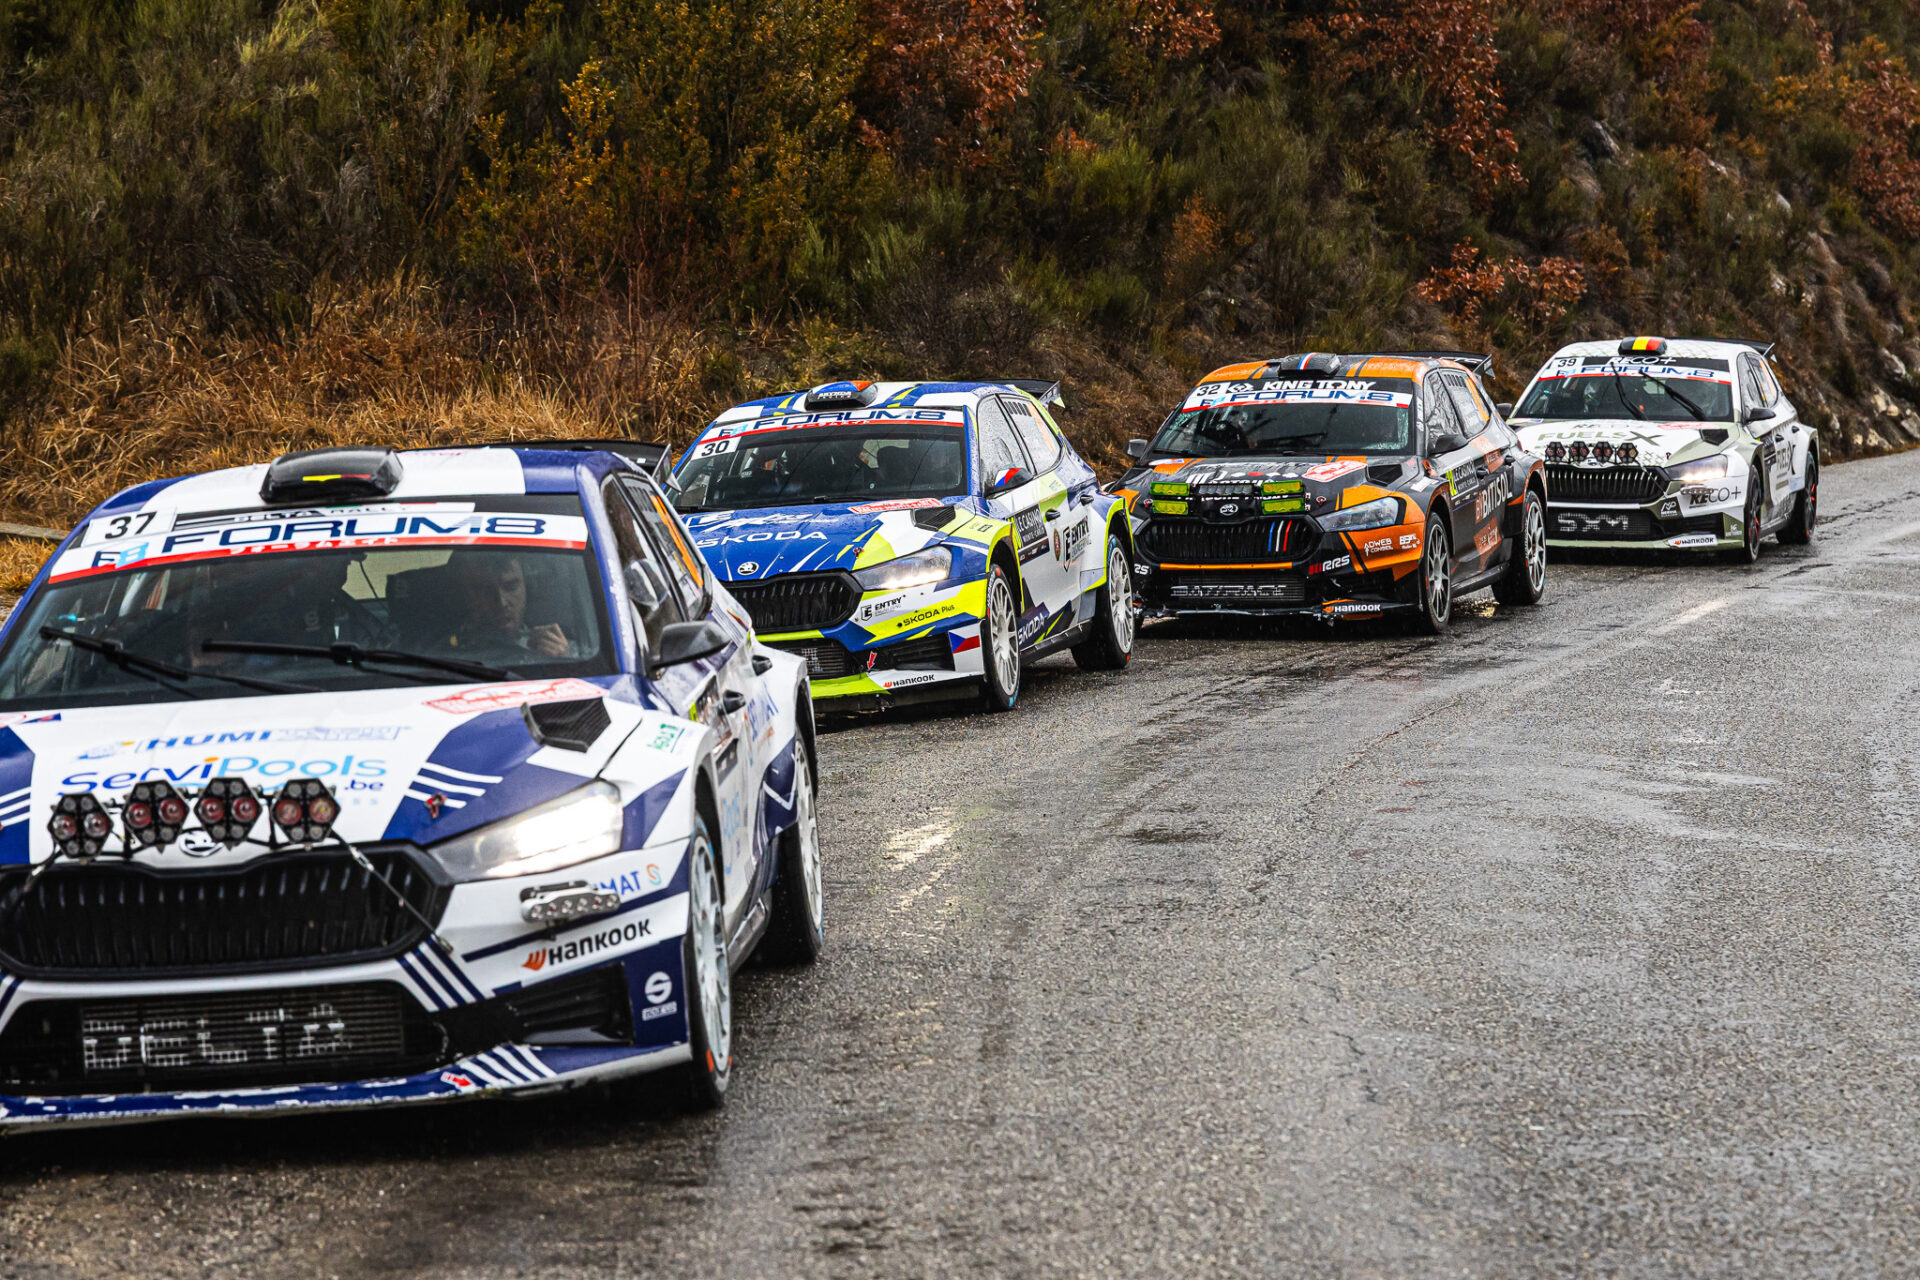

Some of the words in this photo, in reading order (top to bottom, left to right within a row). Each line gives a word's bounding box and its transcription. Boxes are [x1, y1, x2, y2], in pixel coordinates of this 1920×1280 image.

[1558, 358, 1577, 368] 39
[1196, 385, 1219, 397] 32
[1262, 380, 1313, 391] KING
[1315, 380, 1376, 391] TONY
[1231, 390, 1395, 403] FORUM8
[752, 410, 947, 430] FORUM8
[700, 440, 731, 457] 30
[104, 511, 157, 540] 37
[161, 517, 546, 553] FORUM8
[1322, 555, 1351, 572] RRS
[874, 596, 902, 611] ENTRY
[941, 605, 955, 613] Plus
[56, 754, 387, 797] ServiPools
